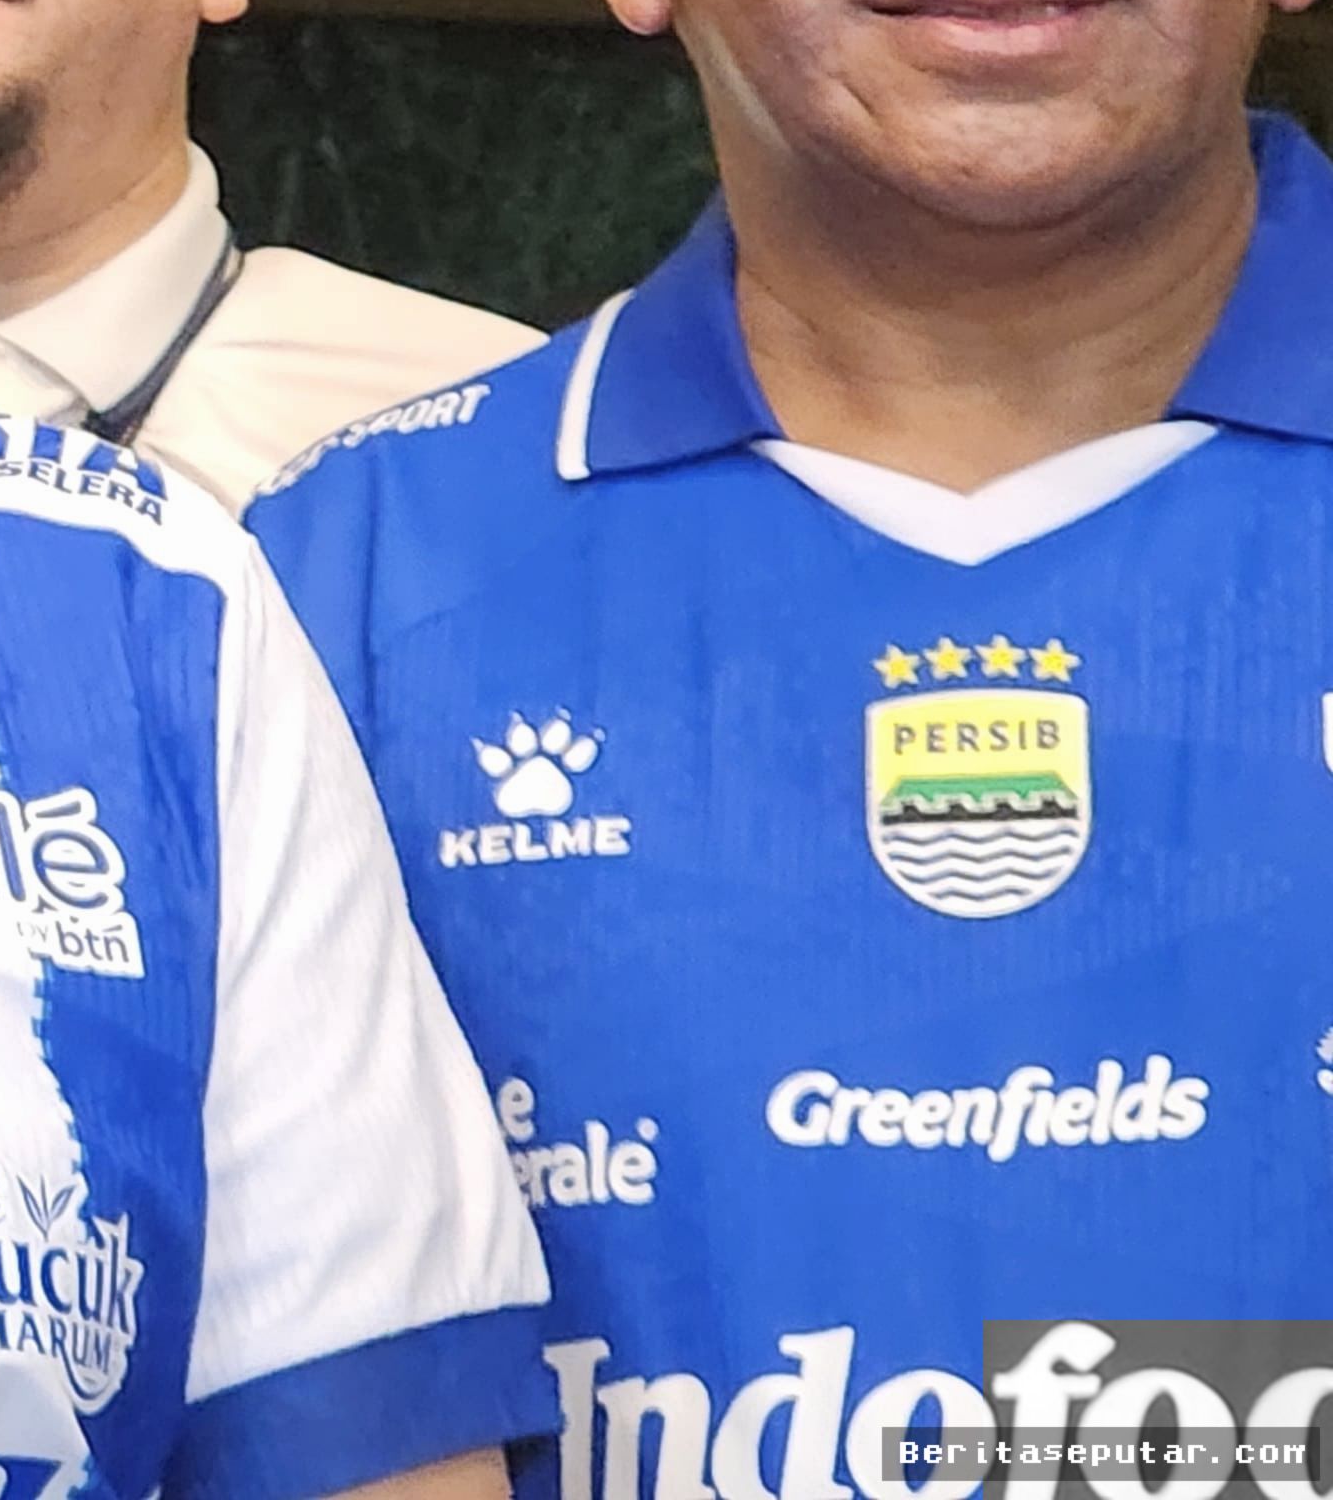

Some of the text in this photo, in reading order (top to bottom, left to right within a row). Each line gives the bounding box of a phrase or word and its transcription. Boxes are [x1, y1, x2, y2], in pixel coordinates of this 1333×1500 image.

[893, 719, 1062, 756] PERSIB
[439, 816, 631, 867] KELME
[766, 1054, 1210, 1162] Greenfields
[541, 1320, 1333, 1500] Indofoo
